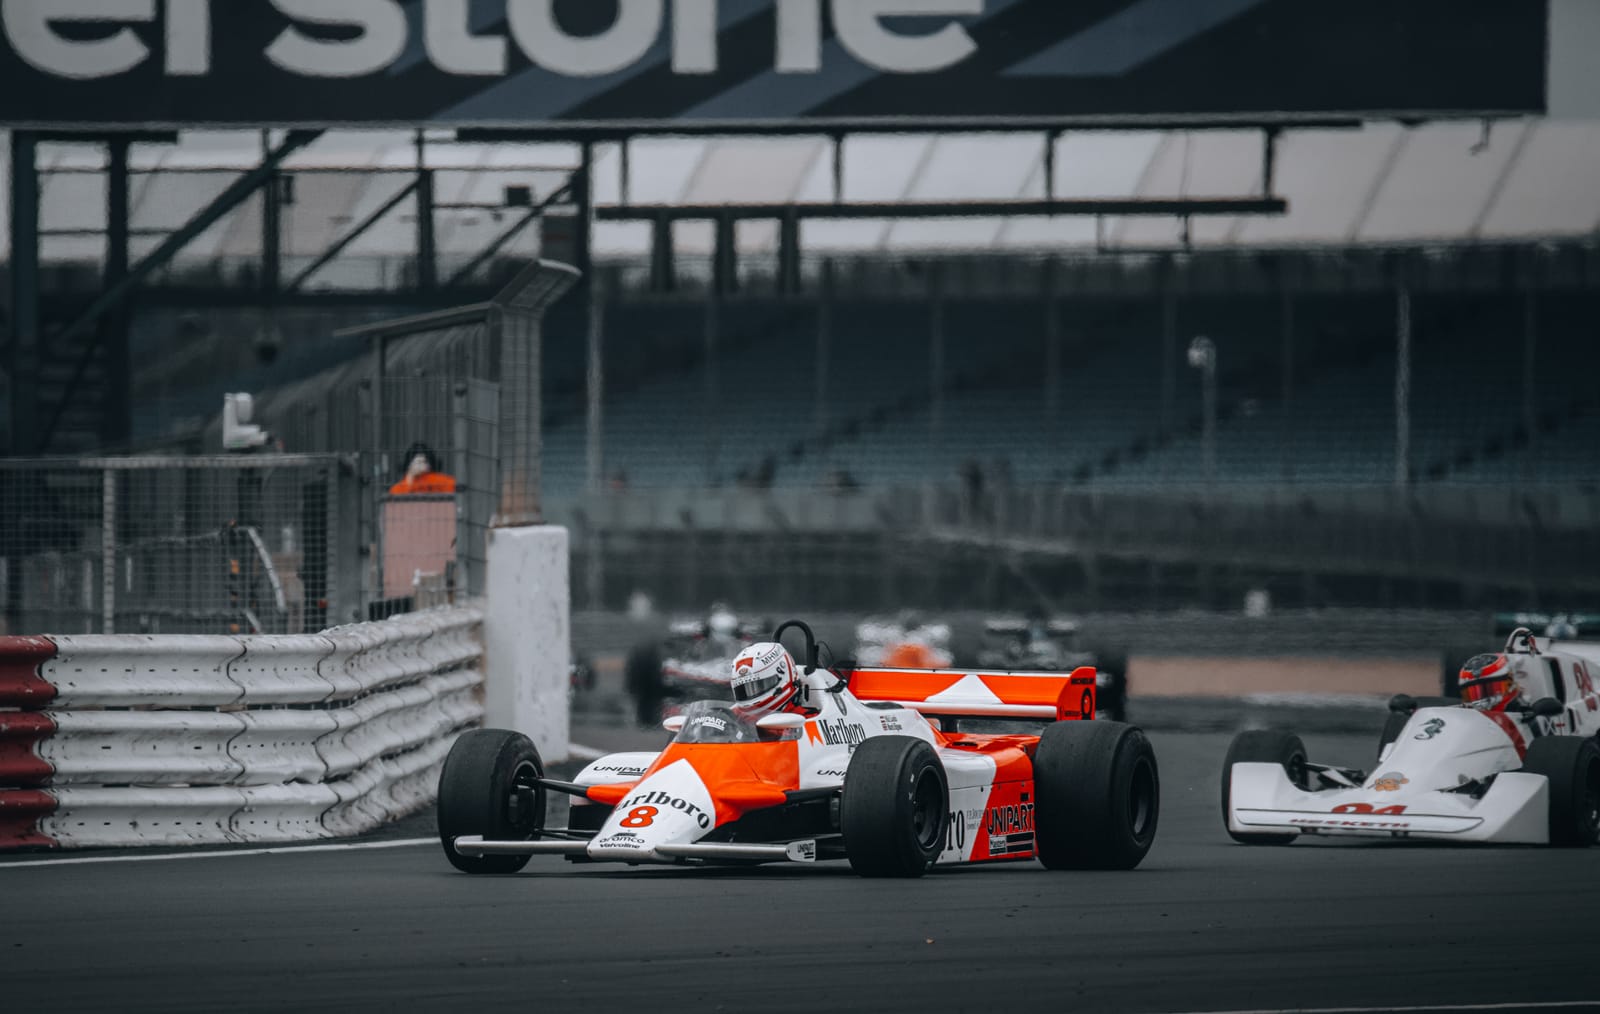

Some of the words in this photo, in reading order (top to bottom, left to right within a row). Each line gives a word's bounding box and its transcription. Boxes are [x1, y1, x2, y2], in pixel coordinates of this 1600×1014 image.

[691, 716, 727, 727] UNIPART
[818, 718, 867, 745] Marlboro
[619, 806, 659, 828] 8
[986, 803, 1034, 835] UNIPART
[599, 836, 646, 844] aramco
